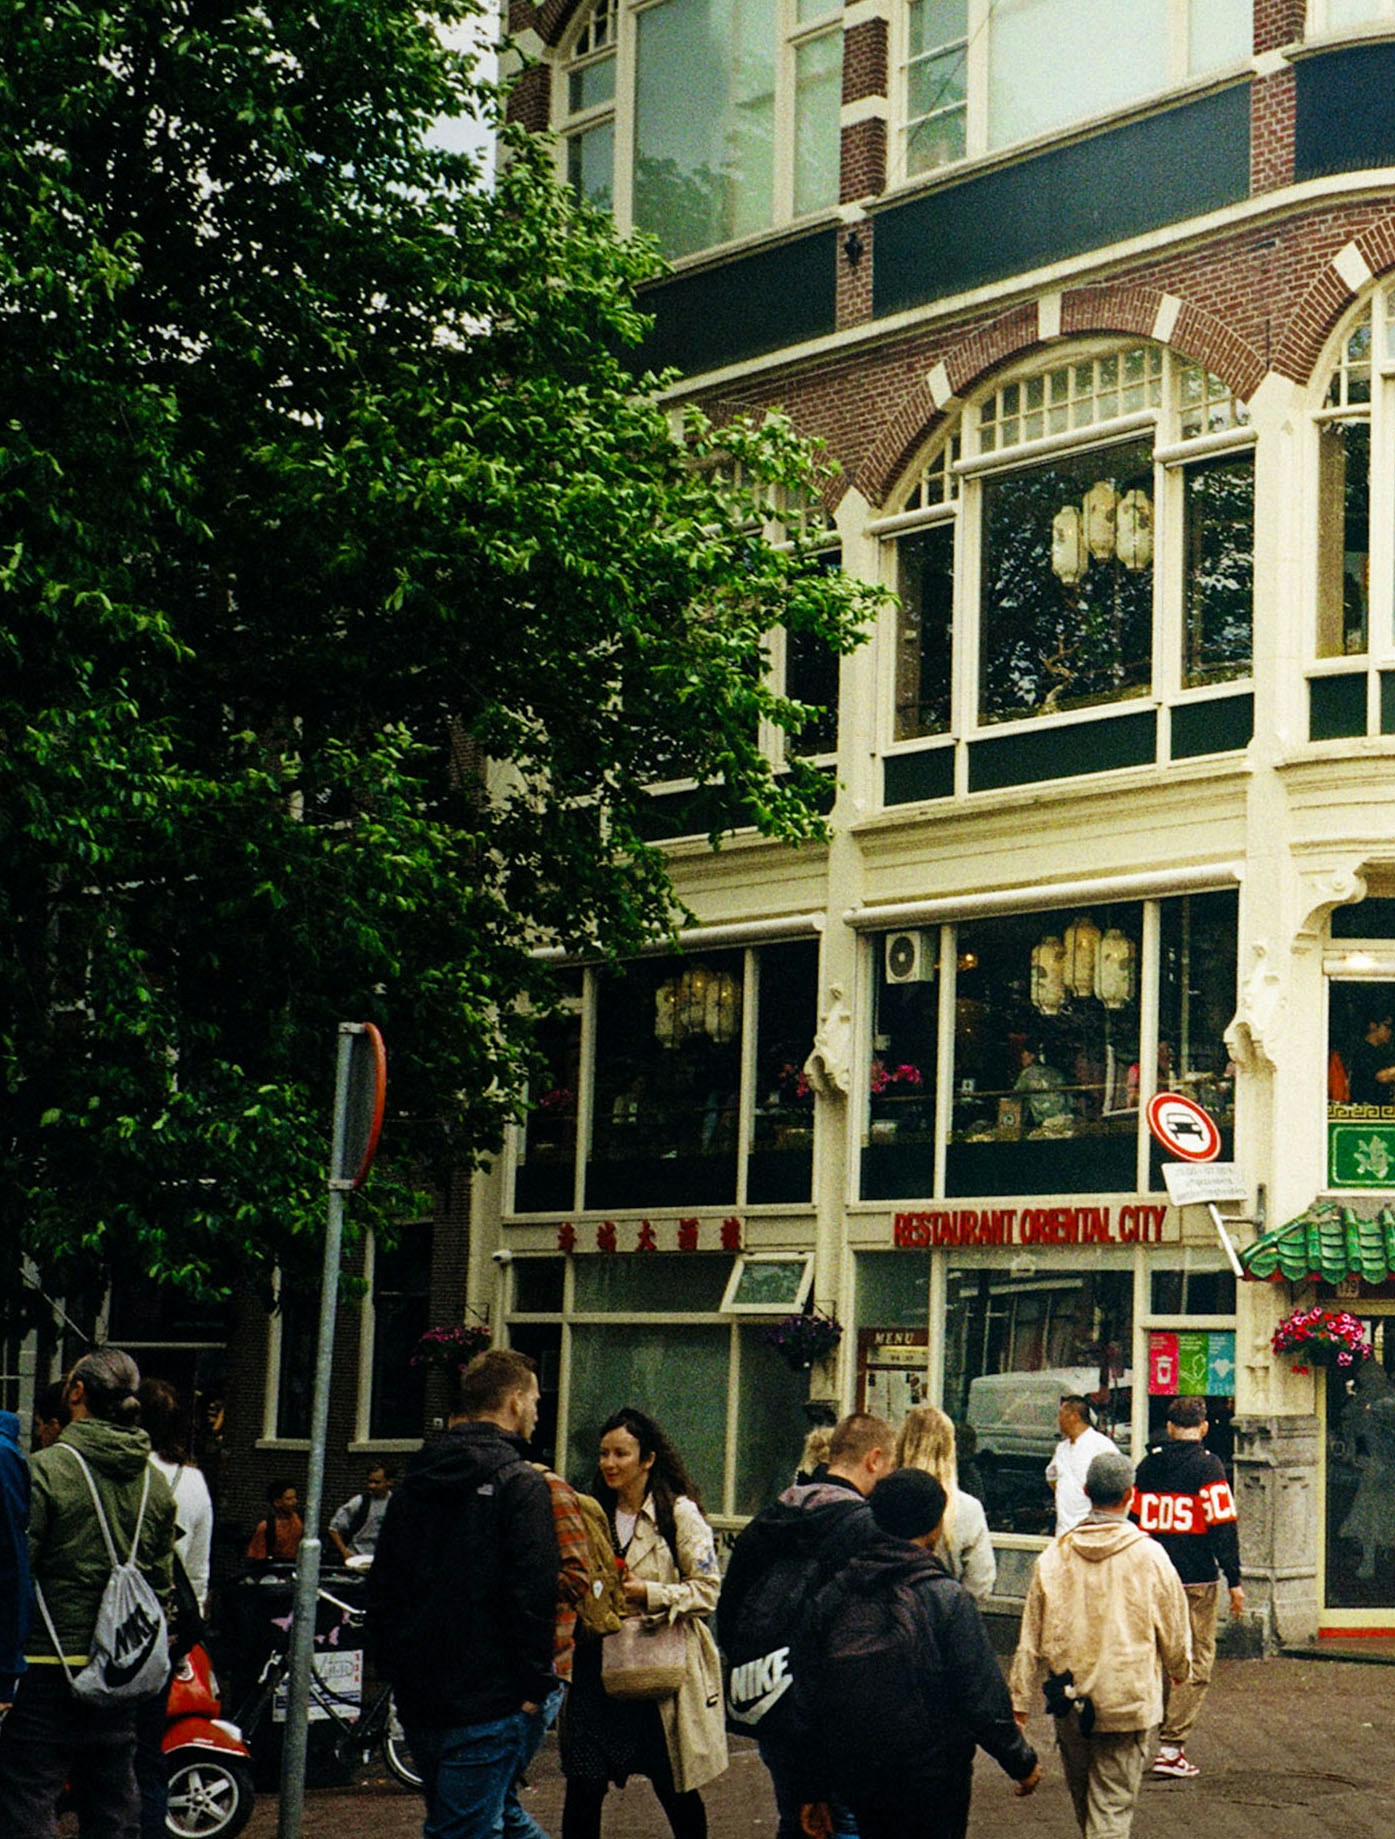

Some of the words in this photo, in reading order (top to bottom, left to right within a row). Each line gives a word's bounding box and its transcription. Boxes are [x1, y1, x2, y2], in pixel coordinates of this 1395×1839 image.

[894, 1210, 1017, 1247] RESTAURANT
[1020, 1207, 1115, 1245] ORIENTAL
[1119, 1205, 1167, 1243] CITY
[875, 1332, 914, 1344] MENU
[730, 1646, 791, 1704] NIKE
